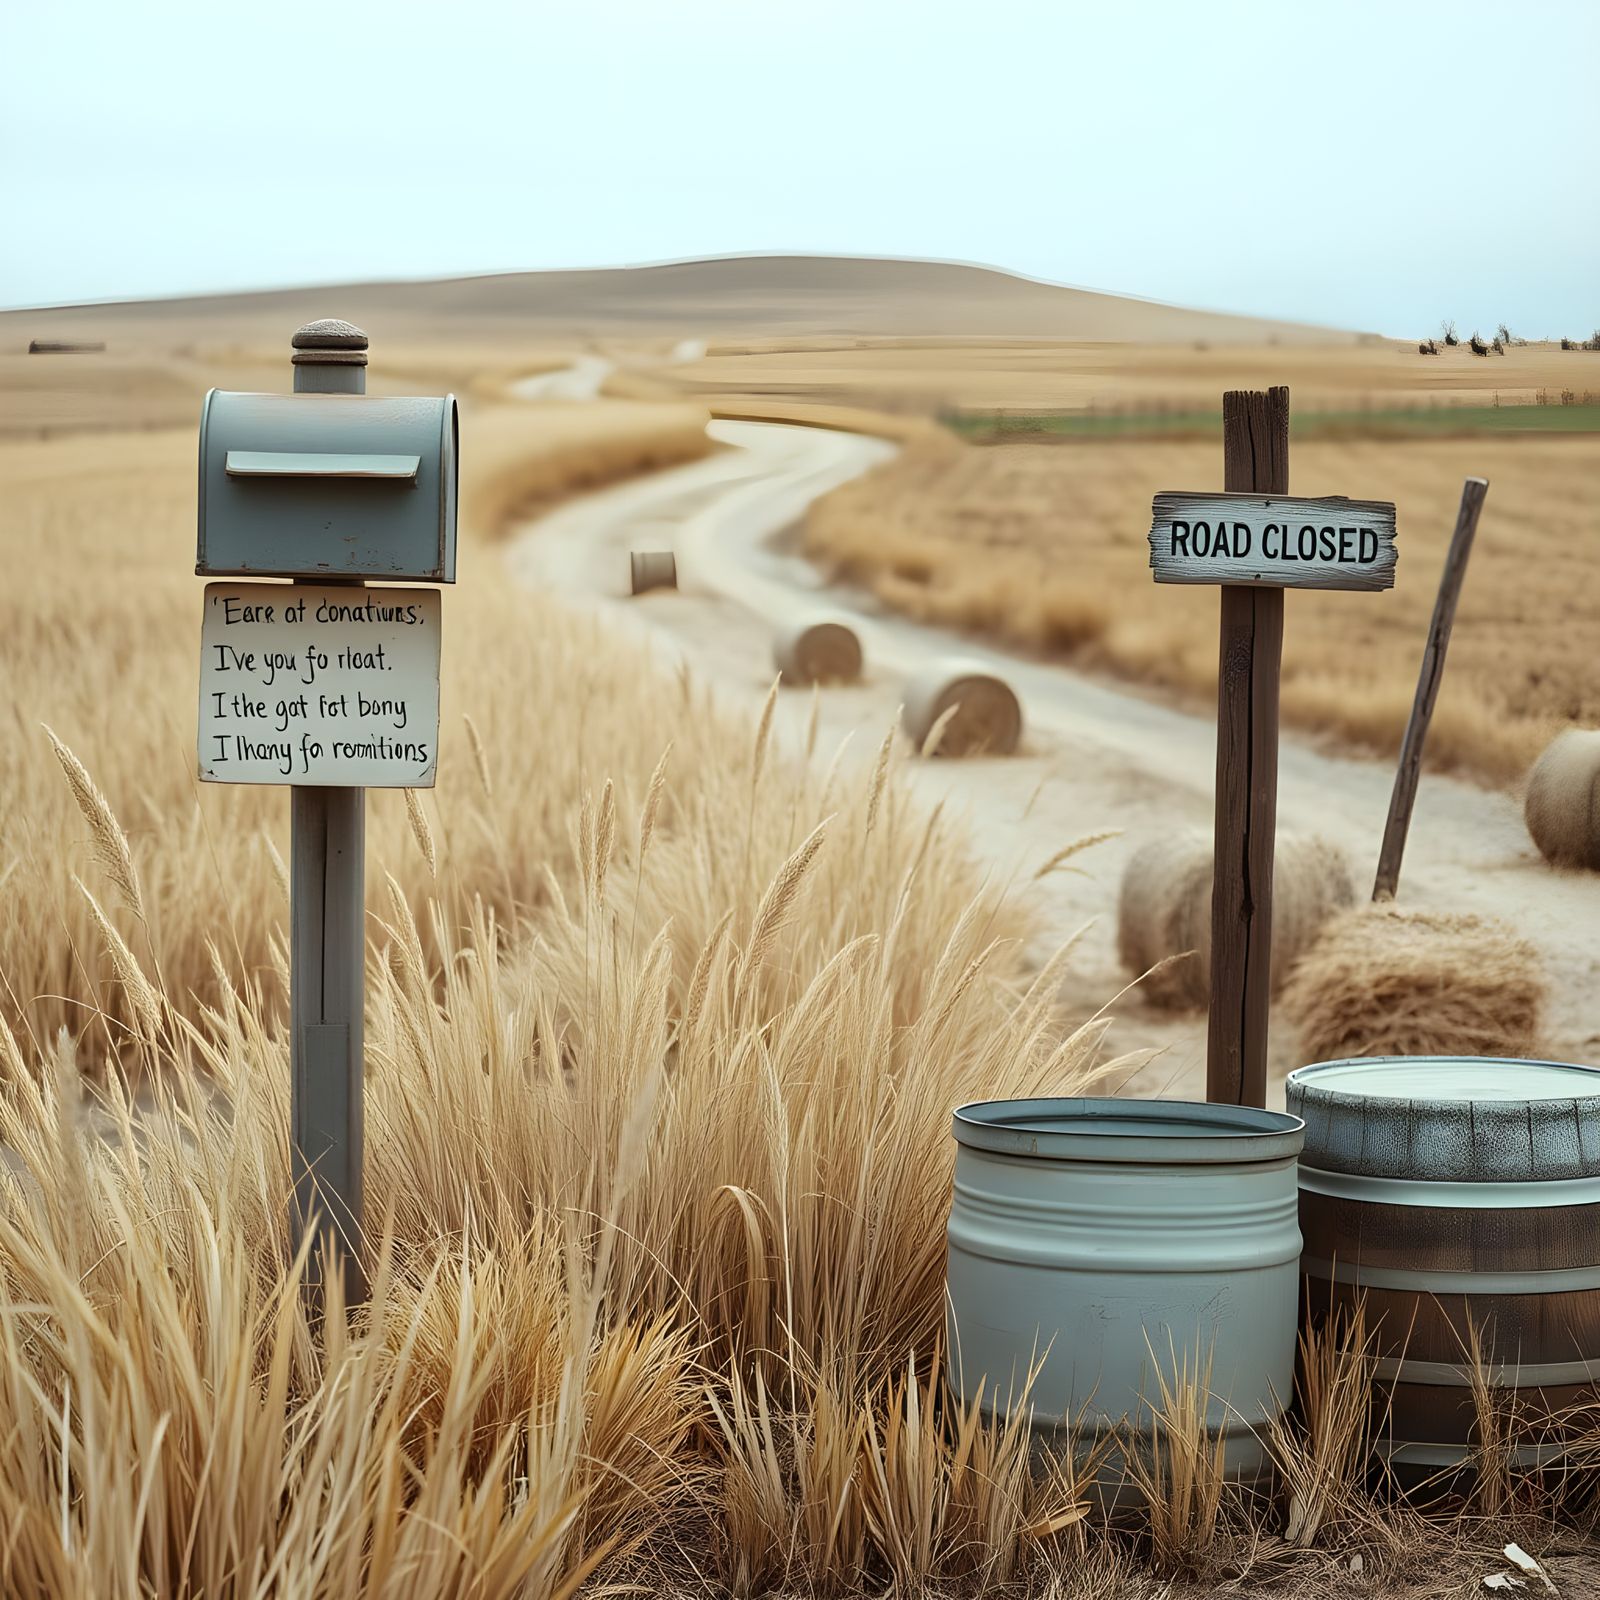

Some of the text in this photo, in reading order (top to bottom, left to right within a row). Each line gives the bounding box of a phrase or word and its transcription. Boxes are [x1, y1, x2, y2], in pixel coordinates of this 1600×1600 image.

[1171, 520, 1379, 564] ROAD CLOSED
[263, 653, 296, 685] you
